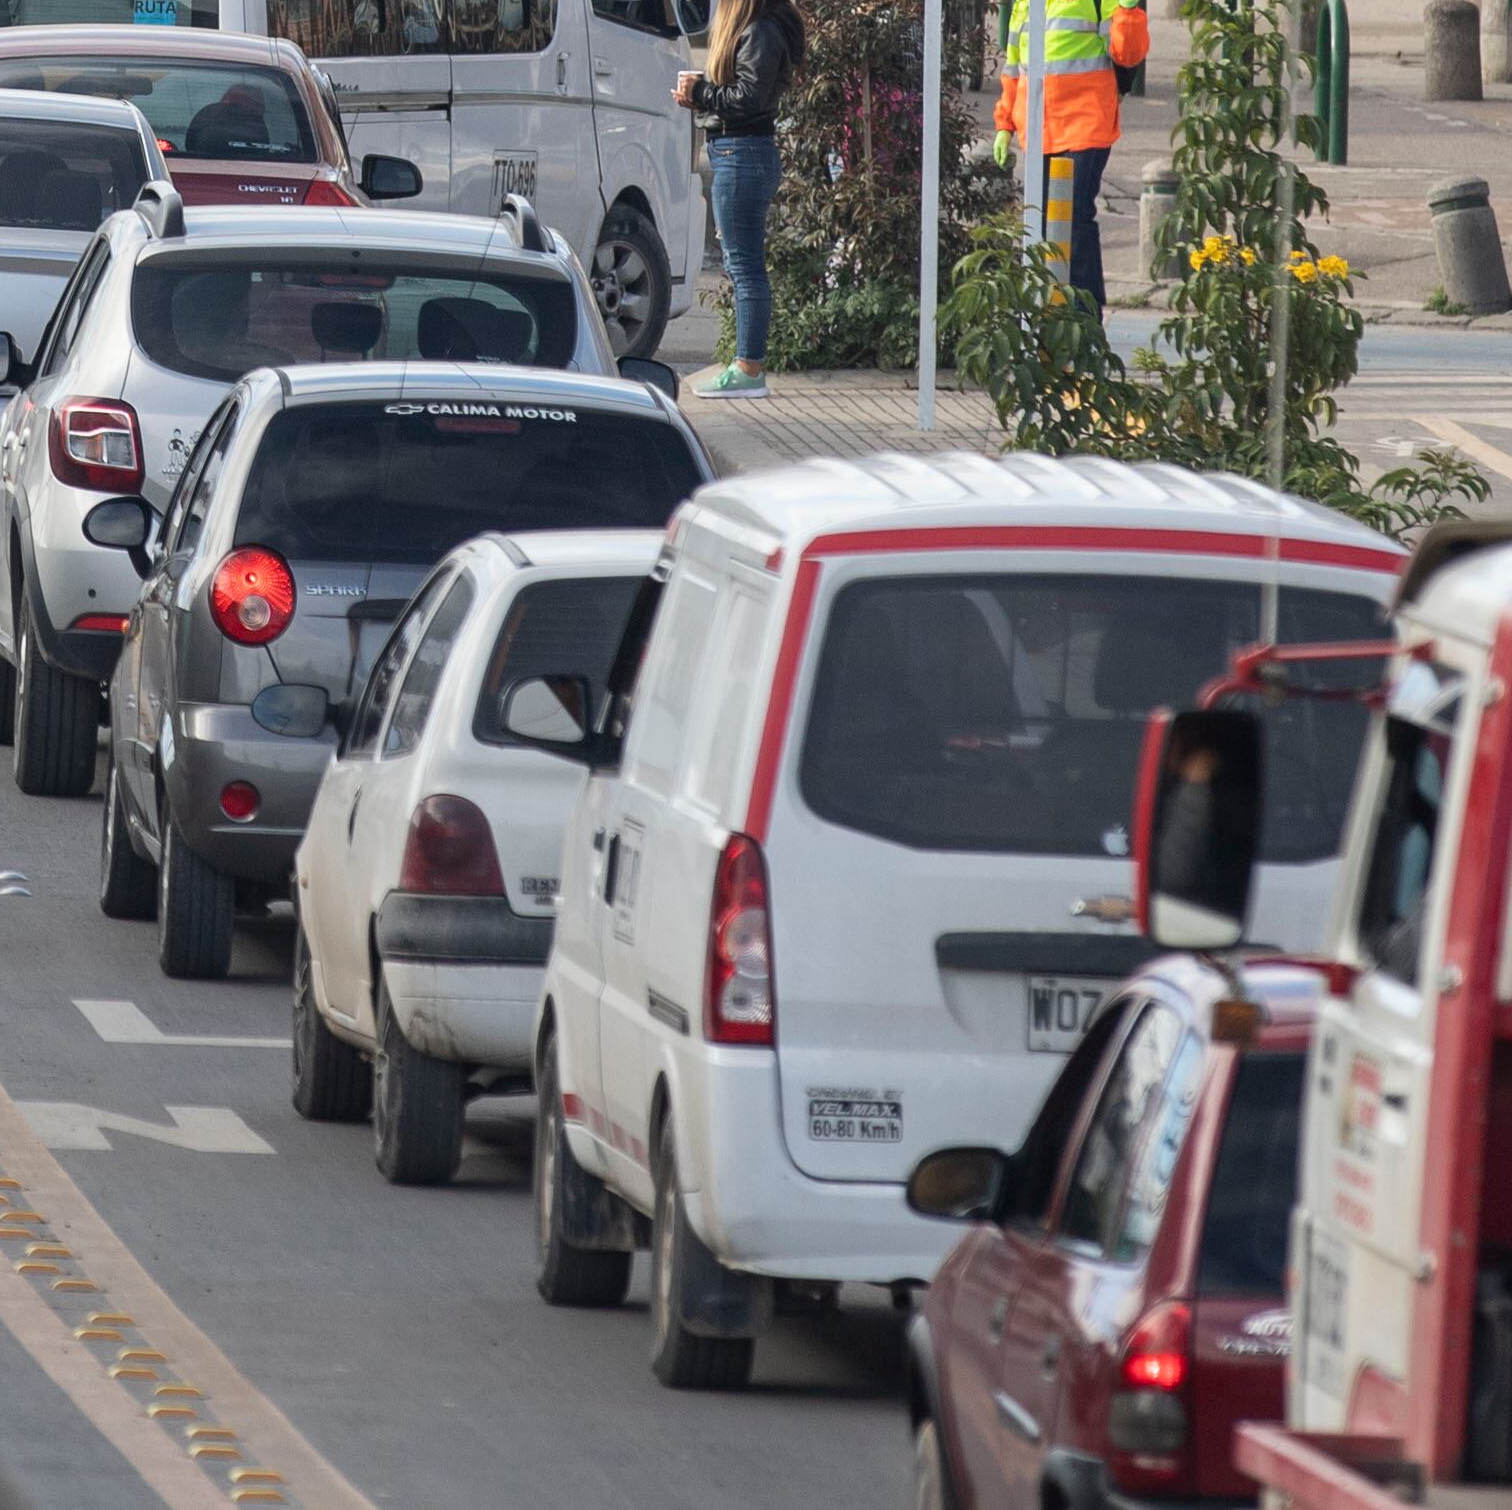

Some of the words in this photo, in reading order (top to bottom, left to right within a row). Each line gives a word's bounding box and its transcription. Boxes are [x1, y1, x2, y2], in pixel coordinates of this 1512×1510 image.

[134, 0, 177, 14] RUTA
[238, 184, 297, 194] CHEVROLET
[427, 403, 500, 417] CALIMA
[505, 406, 577, 423] MOTOR
[305, 585, 367, 596] SPARK
[813, 1119, 856, 1138] 60-80
